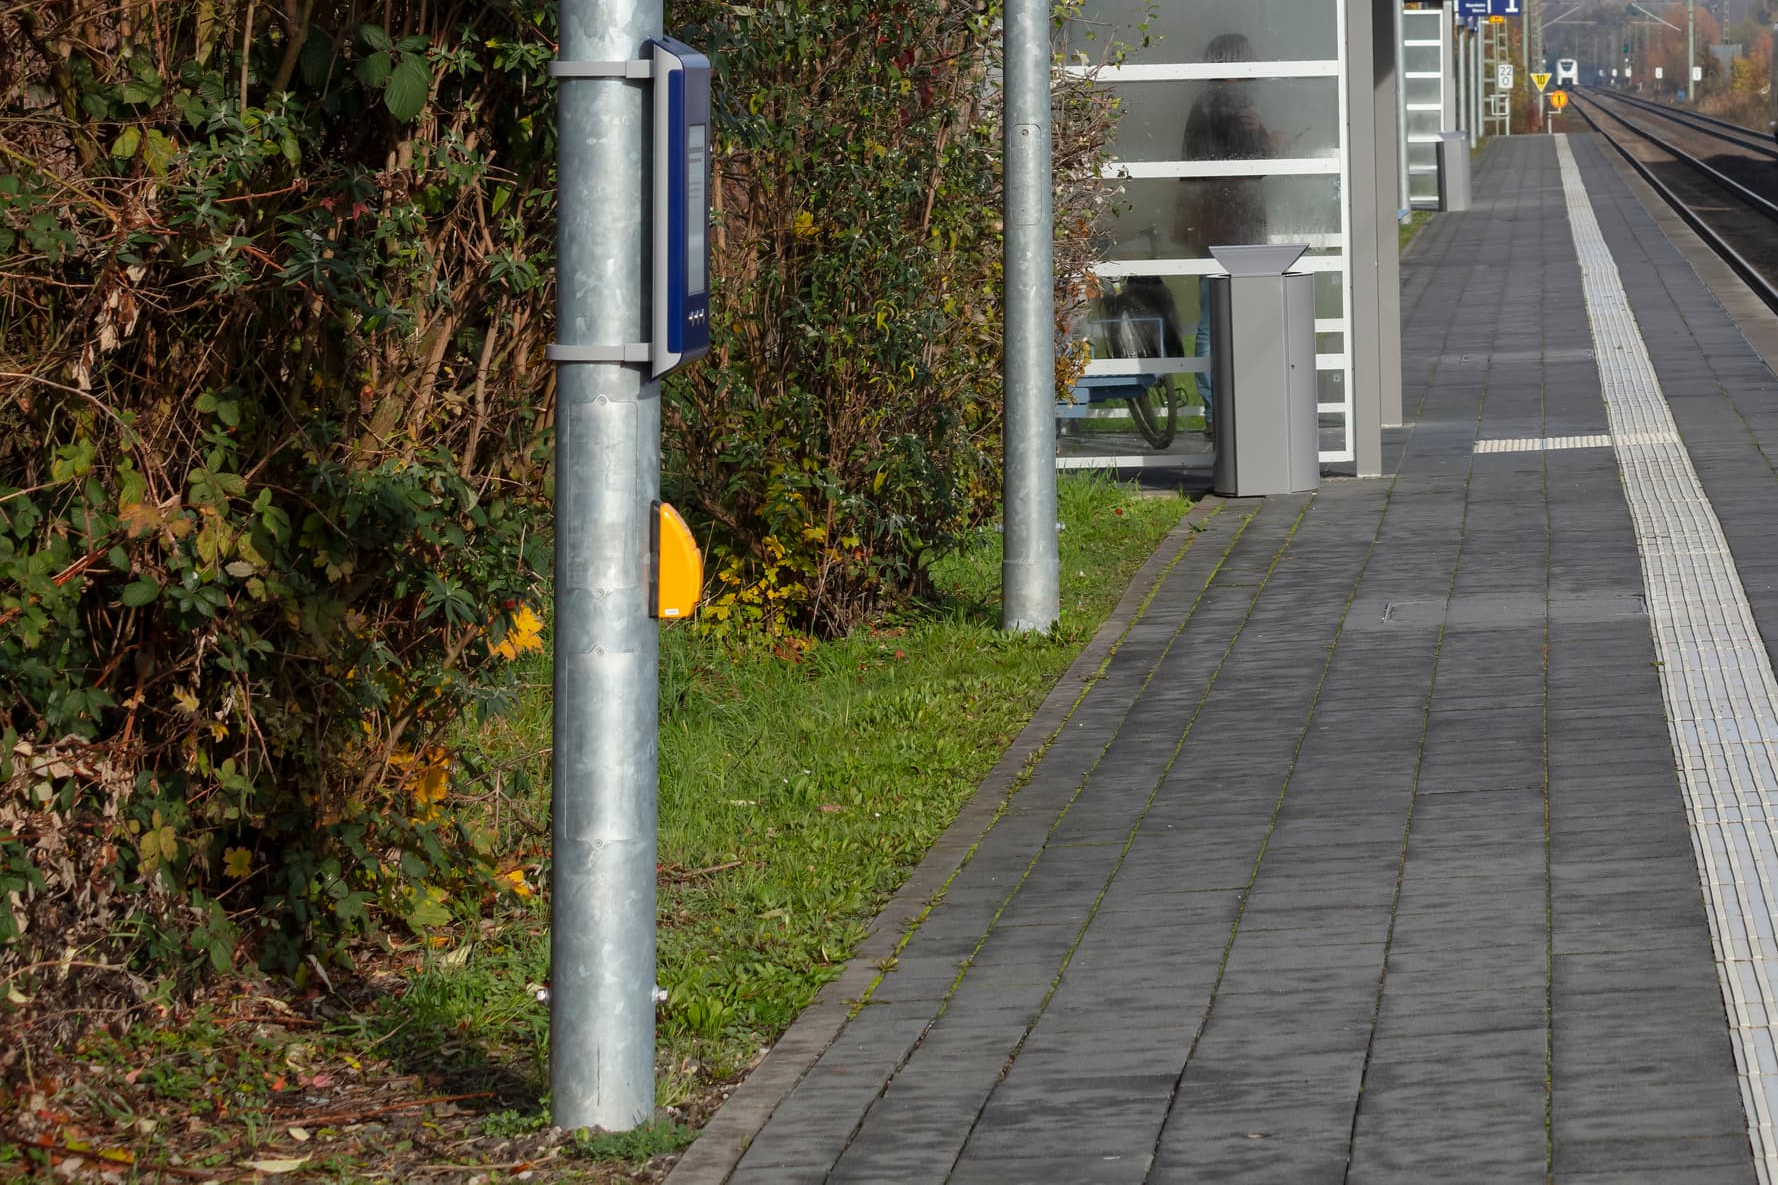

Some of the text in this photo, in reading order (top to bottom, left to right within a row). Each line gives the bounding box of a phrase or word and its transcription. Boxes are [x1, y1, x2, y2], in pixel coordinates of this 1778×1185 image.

[1500, 66, 1512, 76] 22
[1502, 76, 1510, 86] 0
[1537, 74, 1546, 85] 10
